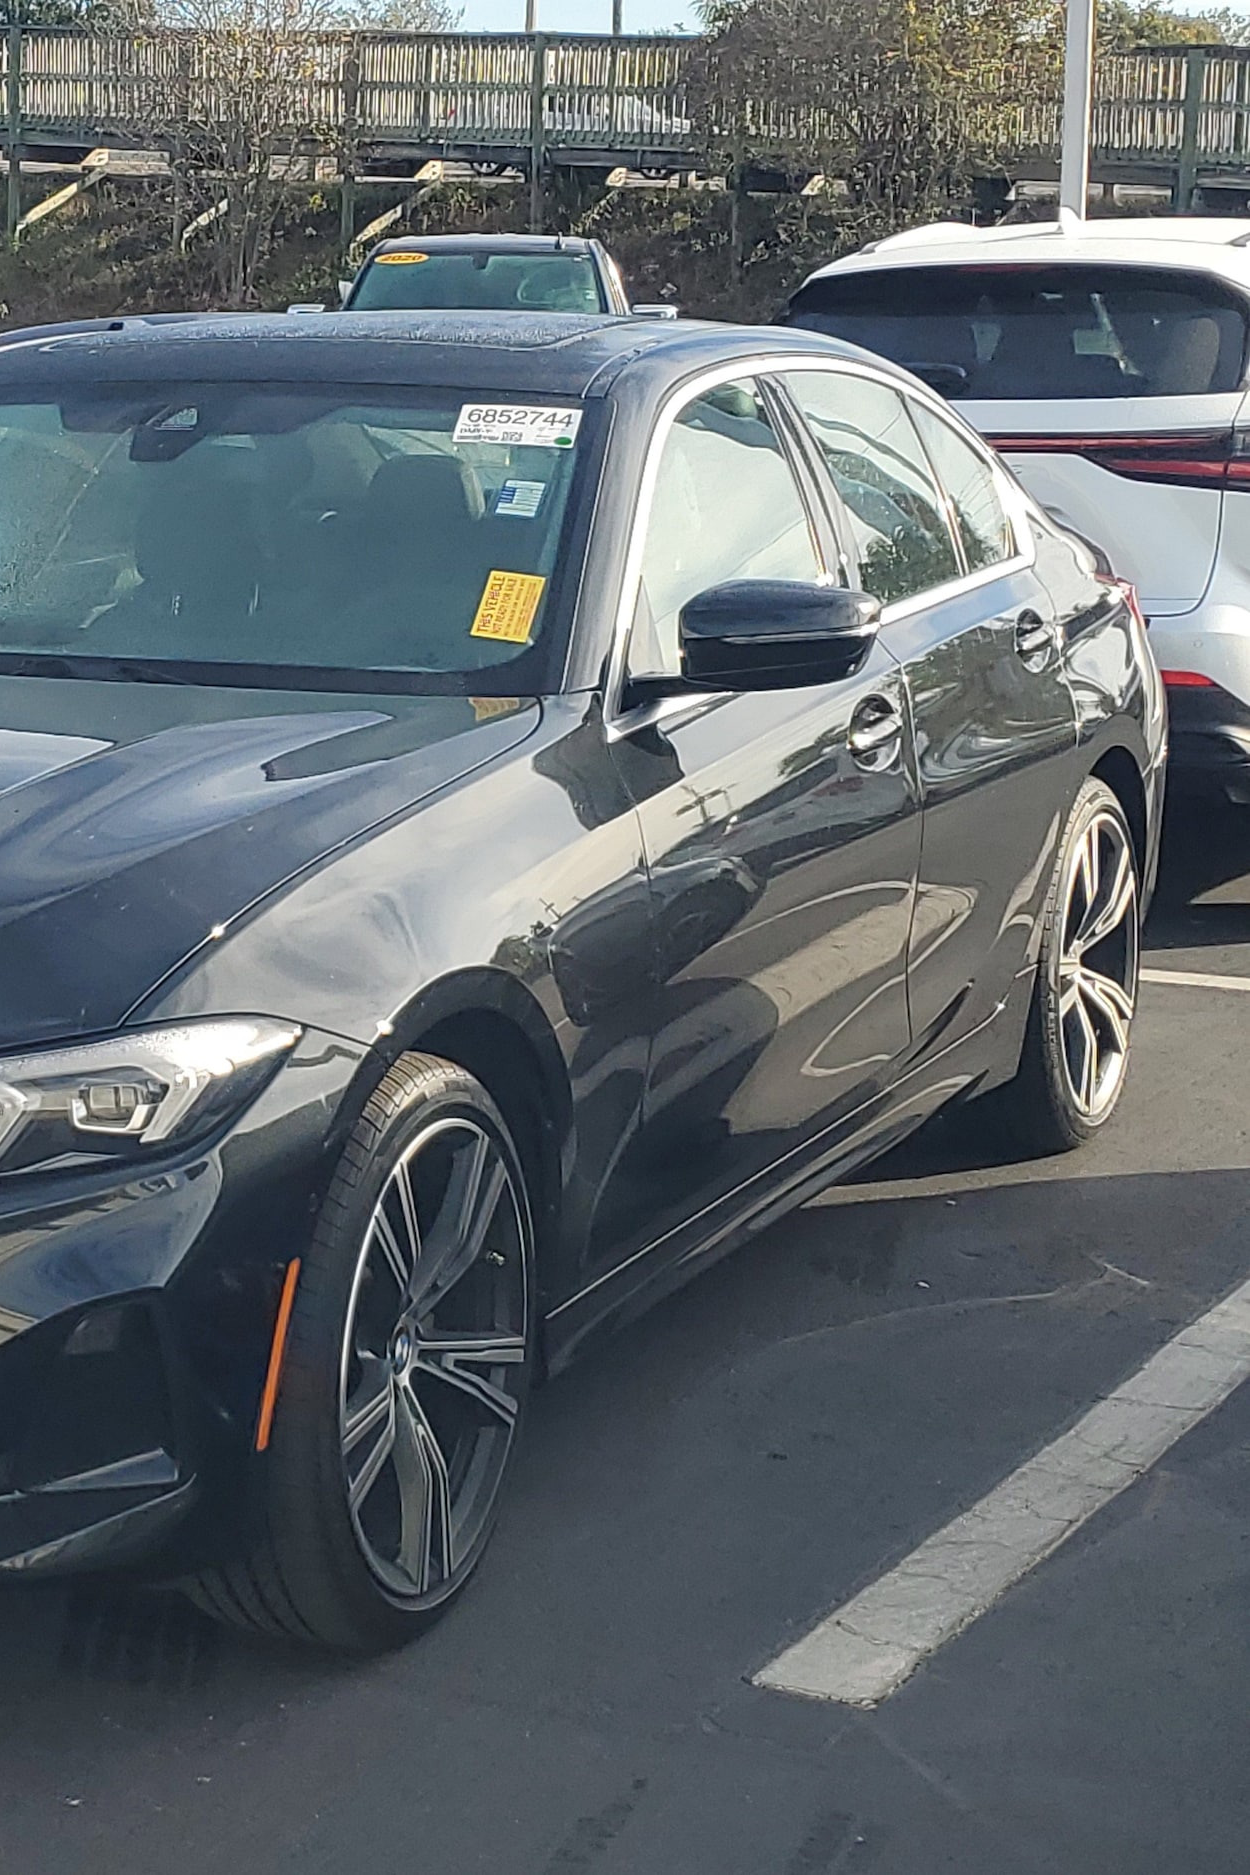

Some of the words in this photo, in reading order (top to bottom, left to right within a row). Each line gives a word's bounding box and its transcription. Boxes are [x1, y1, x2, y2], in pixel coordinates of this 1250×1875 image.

[467, 408, 574, 428] 6852744
[483, 576, 505, 611] VEHICLE
[476, 613, 493, 633] THIS
